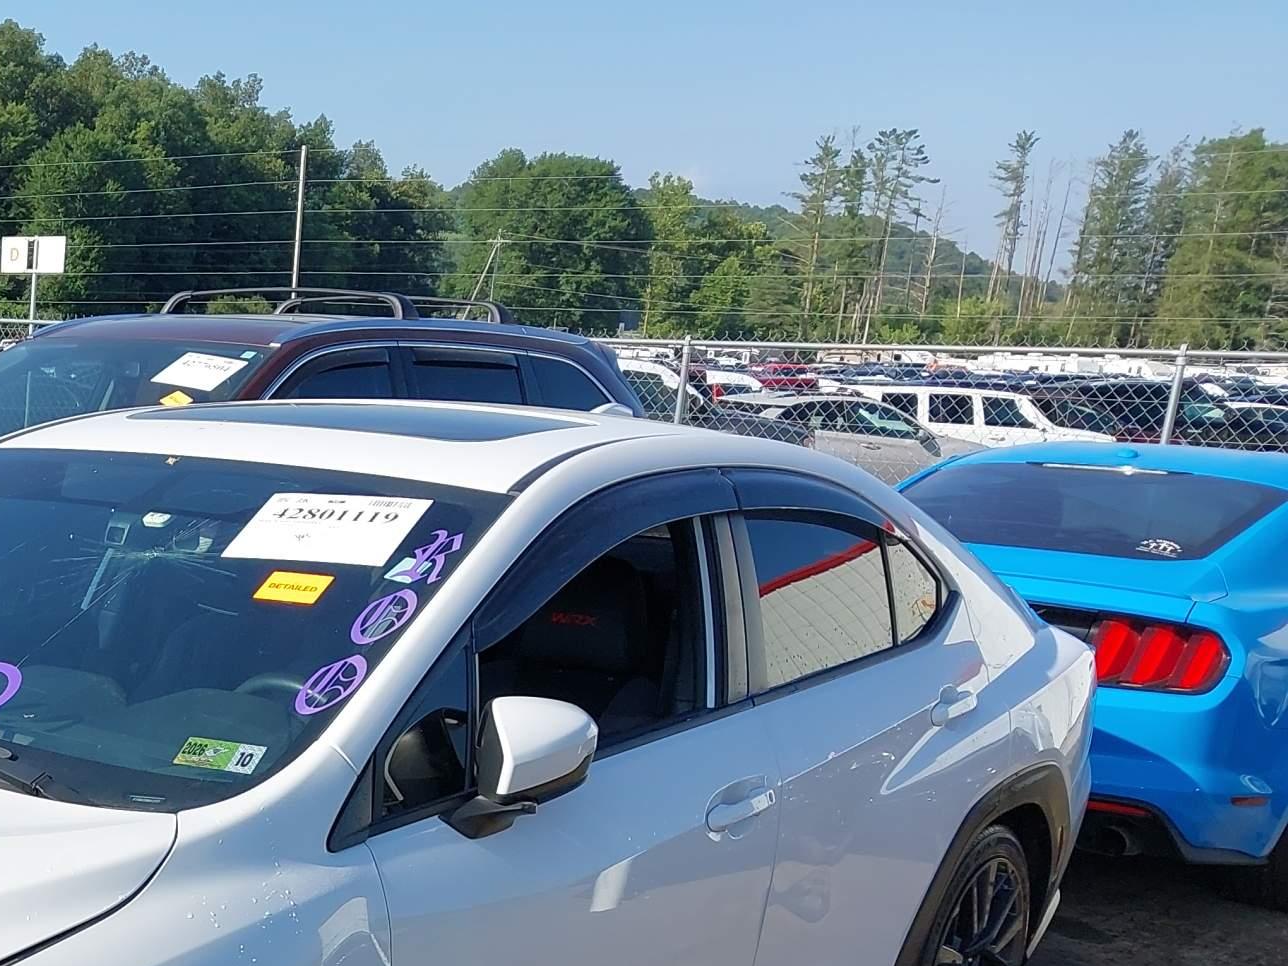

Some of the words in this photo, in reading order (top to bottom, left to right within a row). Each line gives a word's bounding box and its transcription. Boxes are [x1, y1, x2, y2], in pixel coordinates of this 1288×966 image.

[10, 247, 20, 262] D
[271, 508, 401, 525] 42801119
[267, 581, 318, 593] DETAILED
[181, 741, 208, 757] 2026
[235, 752, 254, 767] 10
